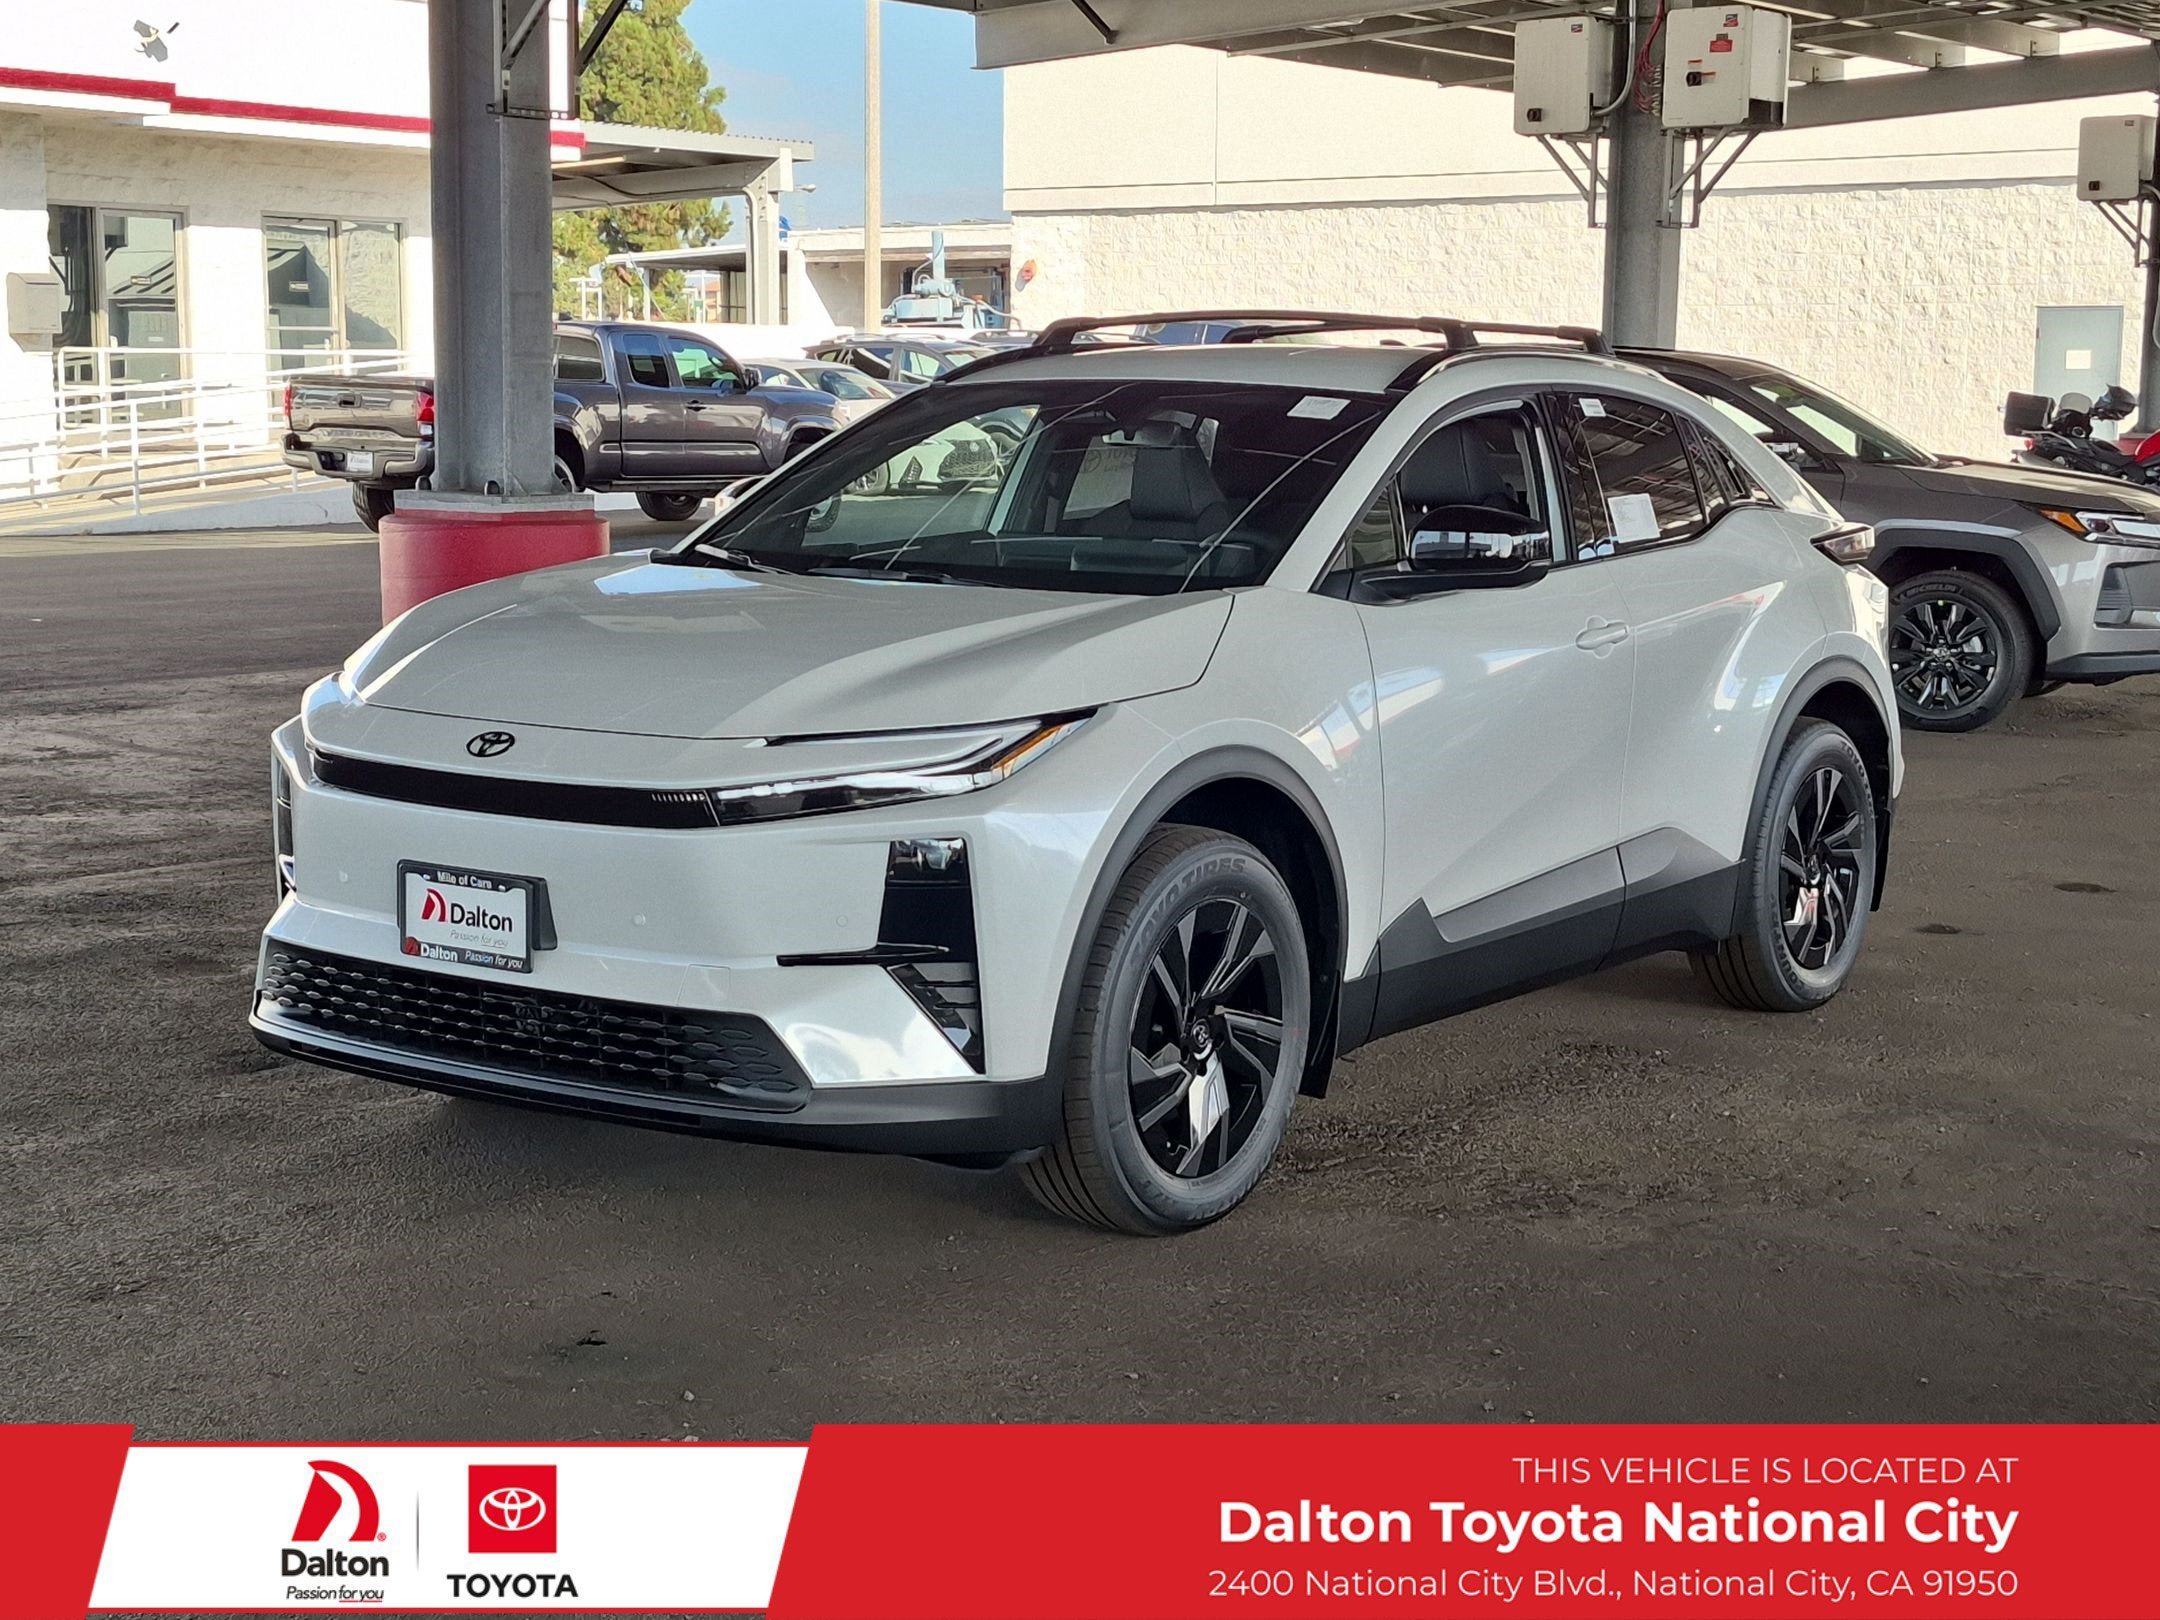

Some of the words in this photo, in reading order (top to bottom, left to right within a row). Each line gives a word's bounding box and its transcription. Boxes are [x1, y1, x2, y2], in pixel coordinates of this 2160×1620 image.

[458, 874, 468, 886] of
[1179, 857, 1246, 888] TIRES
[450, 902, 513, 933] Dalton
[420, 943, 458, 962] Dalton
[464, 950, 494, 965] Passion
[494, 955, 508, 967] for
[507, 958, 523, 969] you
